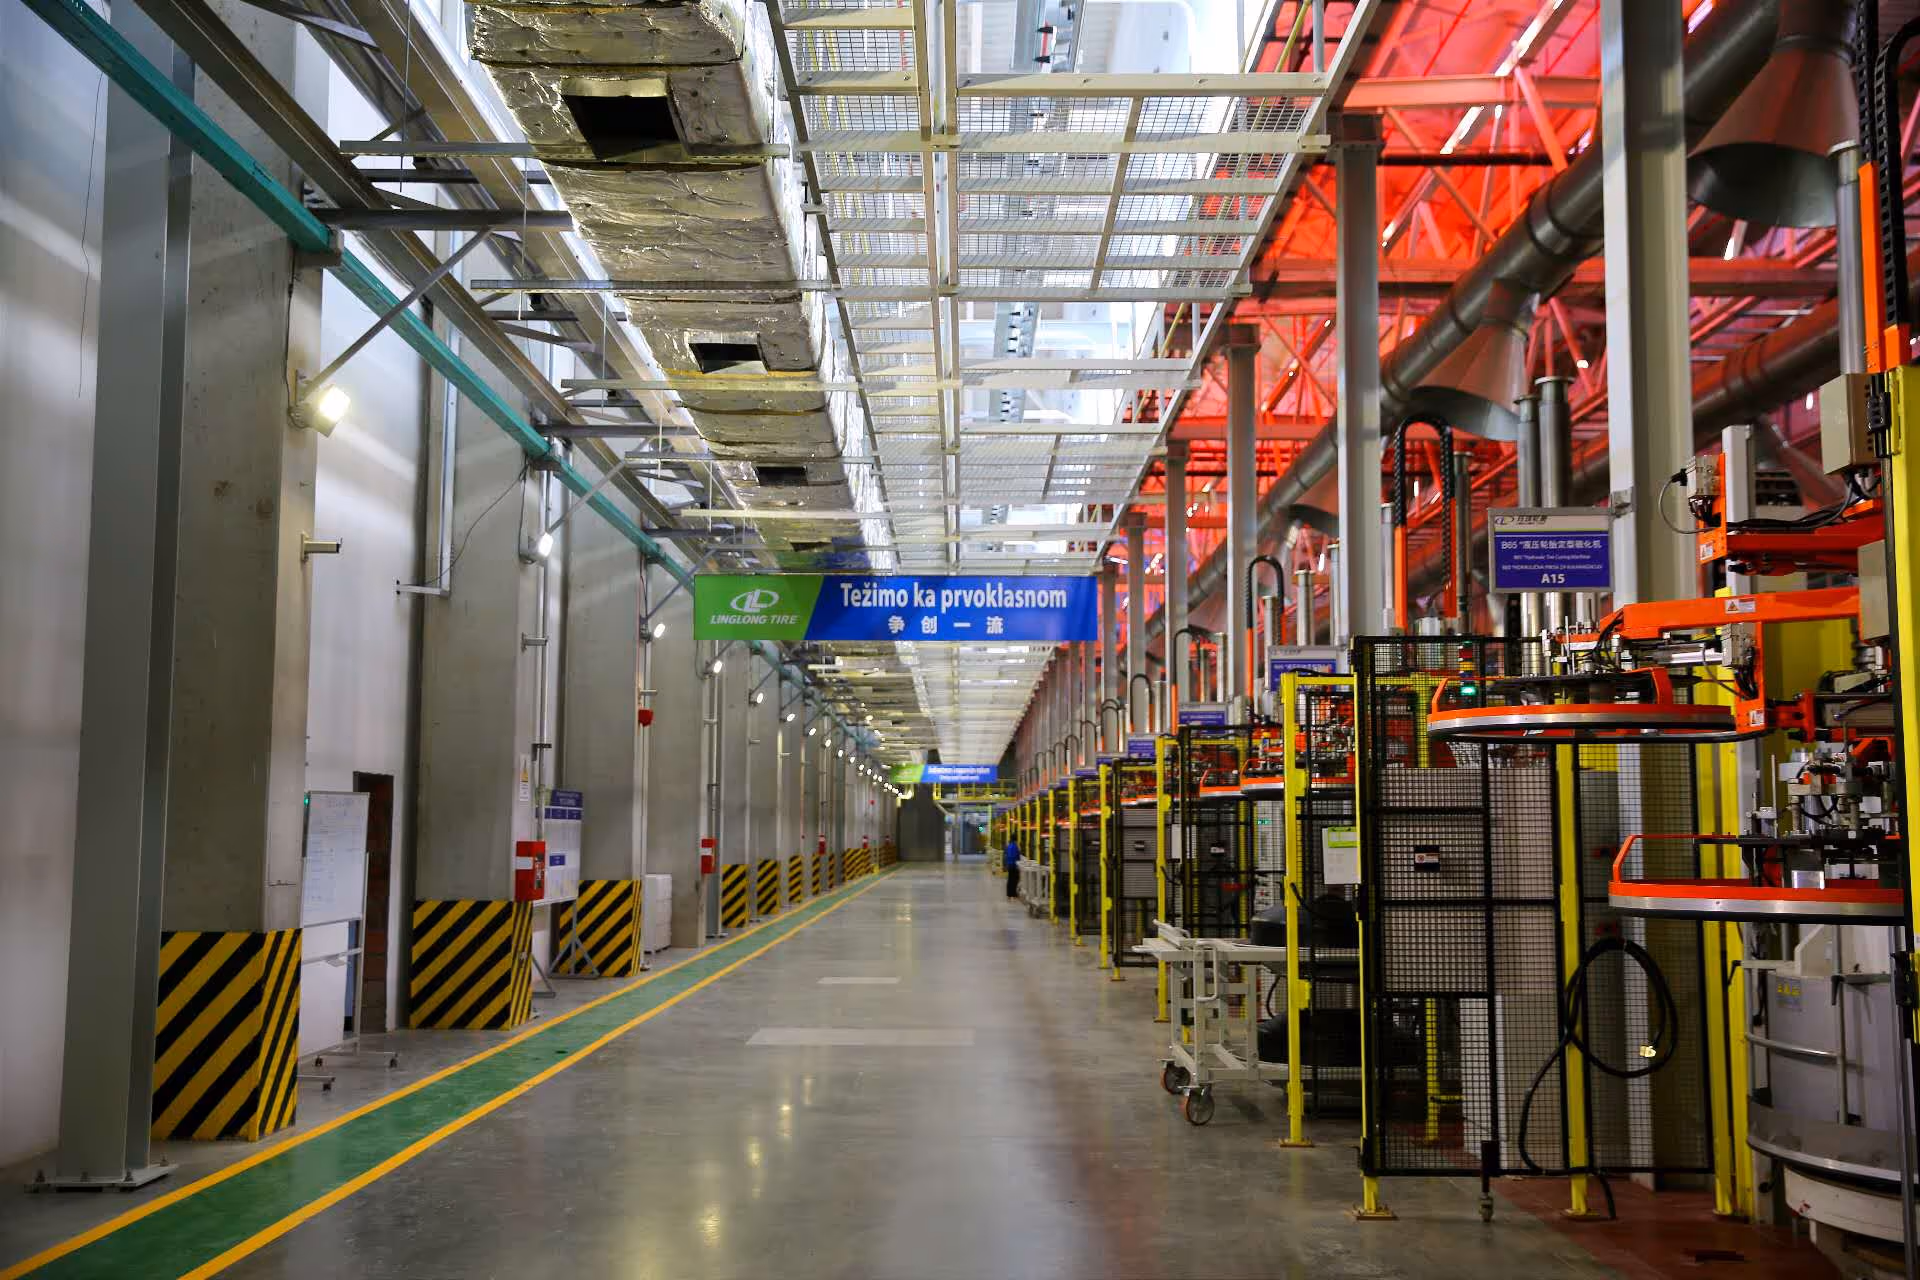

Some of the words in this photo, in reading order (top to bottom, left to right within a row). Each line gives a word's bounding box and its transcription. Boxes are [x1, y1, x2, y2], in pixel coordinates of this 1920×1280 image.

[1541, 573, 1566, 584] A15
[840, 582, 908, 608] Težimo
[913, 582, 936, 608] ka
[941, 582, 1067, 614] prvoklasnom
[710, 614, 768, 625] LINGLONG
[770, 614, 799, 625] TIRE
